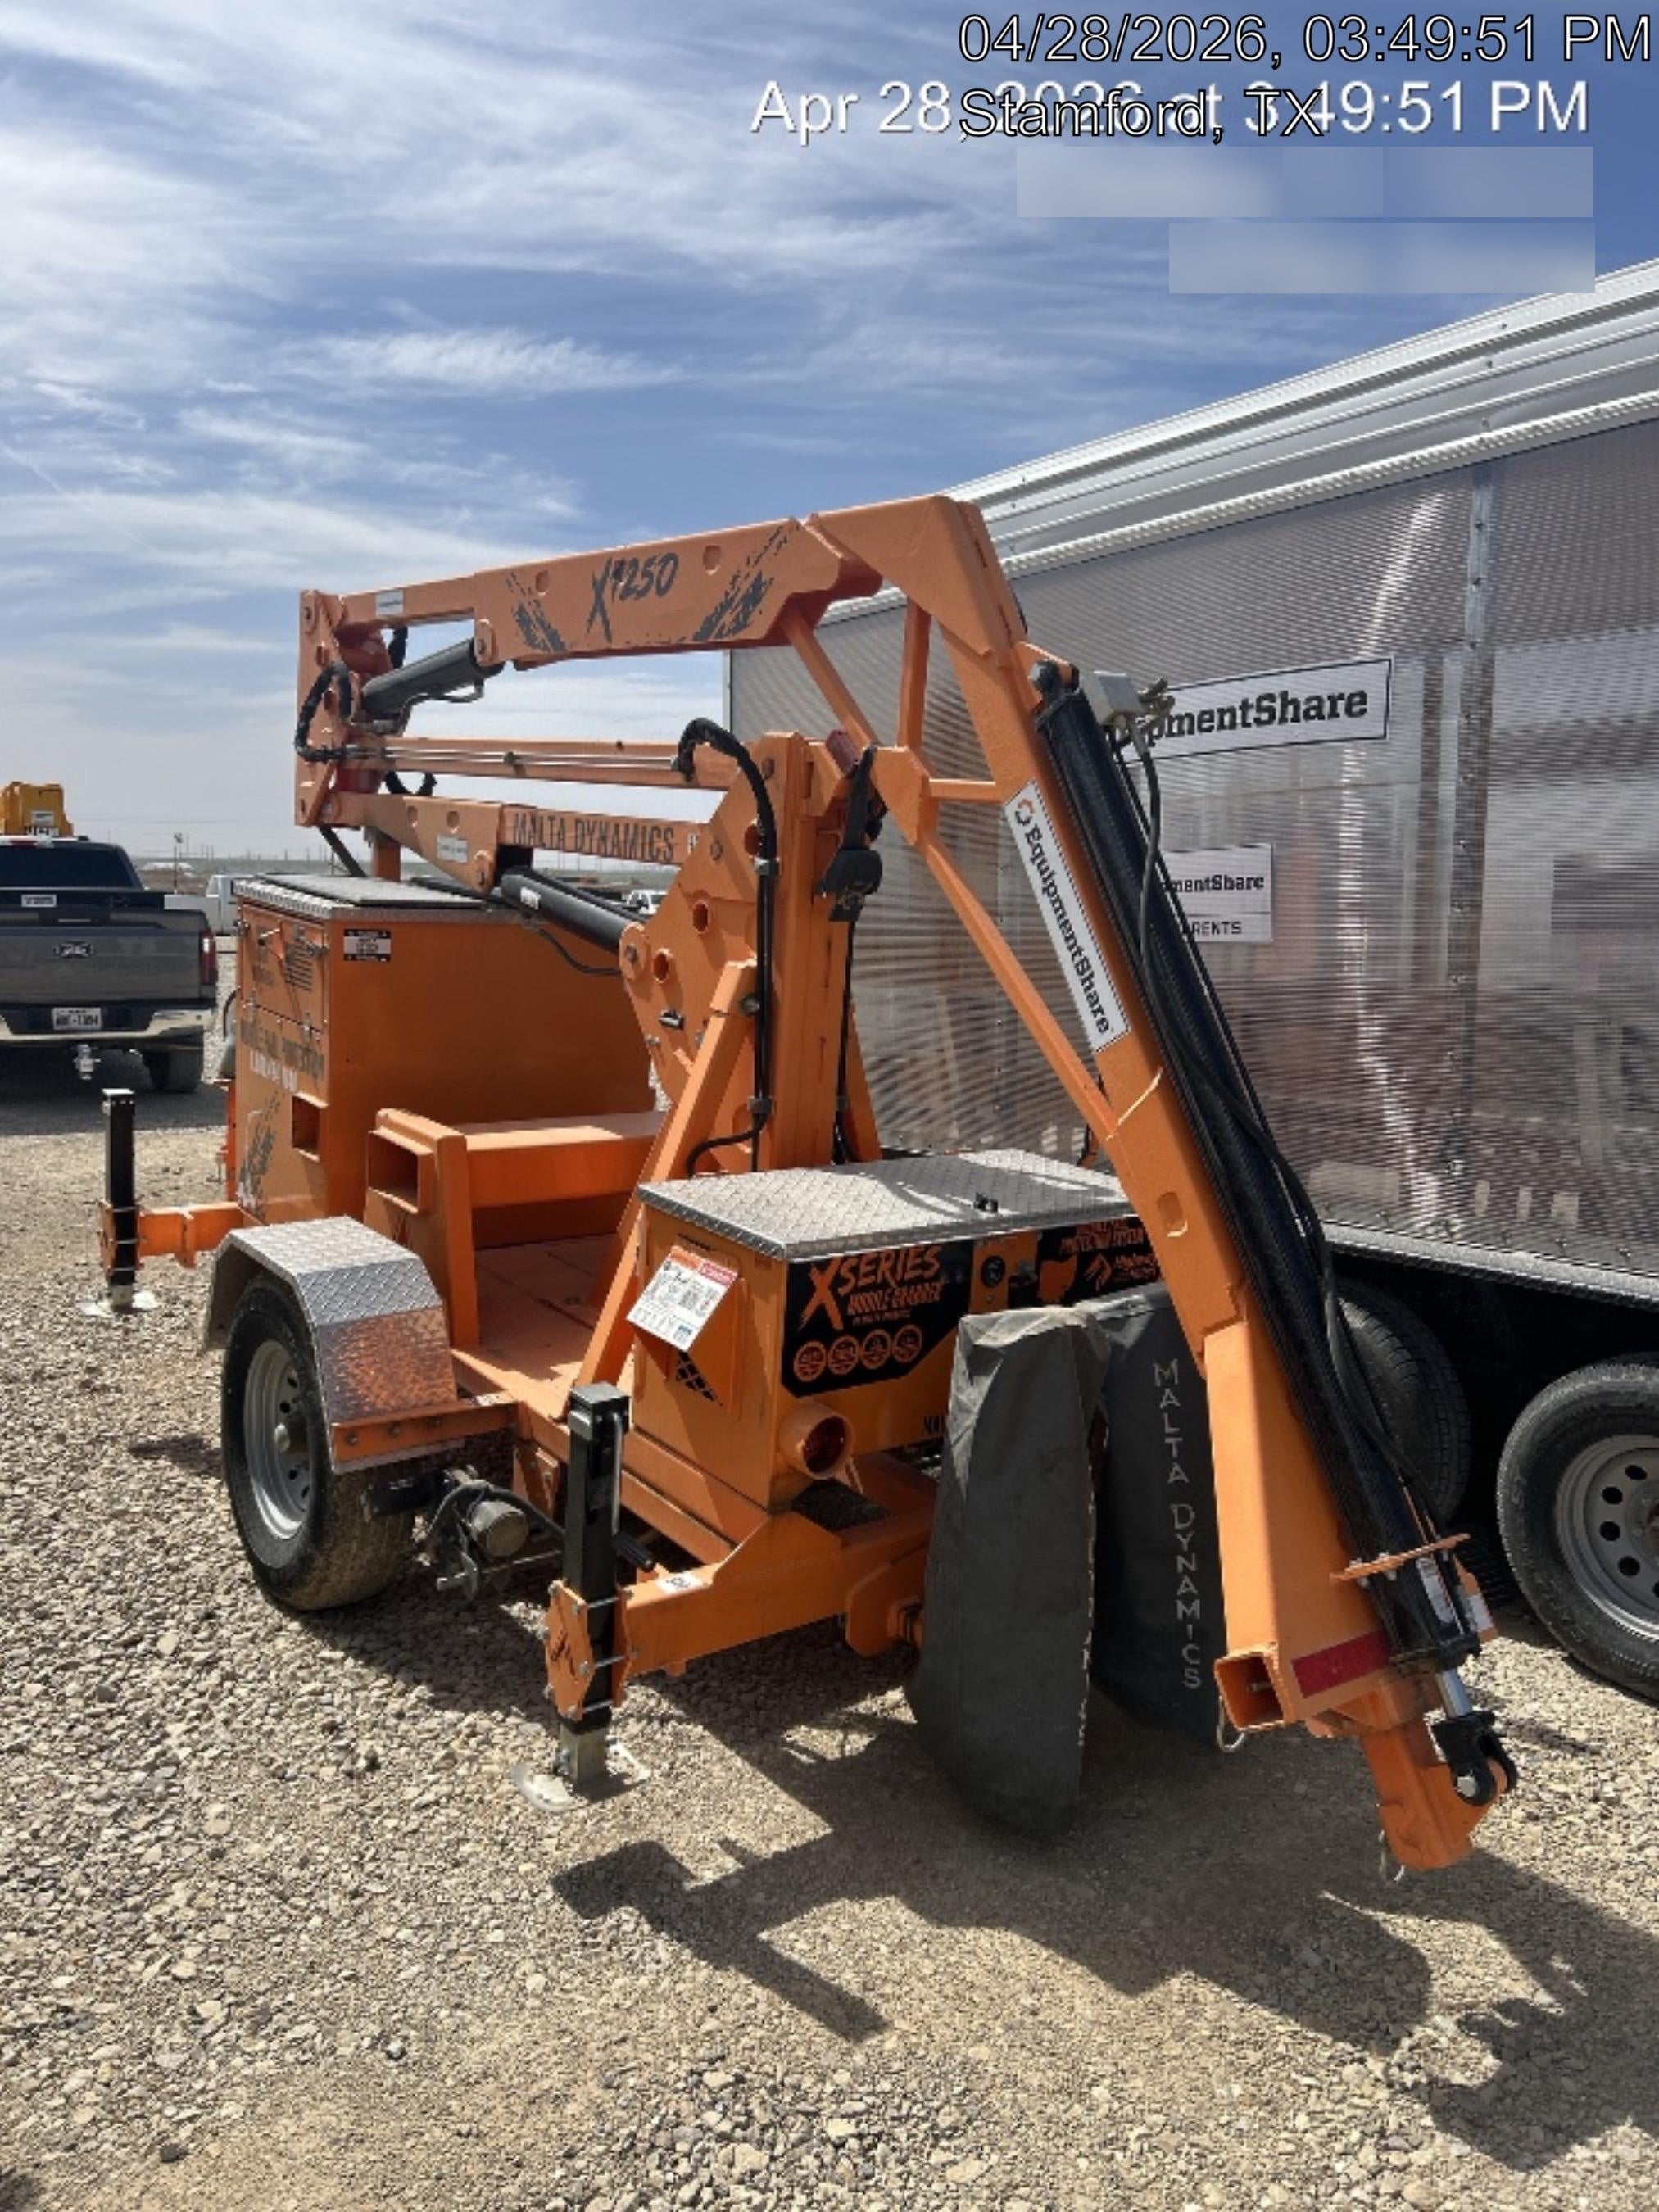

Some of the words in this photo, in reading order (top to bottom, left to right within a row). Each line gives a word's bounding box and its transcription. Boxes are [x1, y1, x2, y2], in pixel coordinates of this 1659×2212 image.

[1117, 689, 1367, 747] pmentShare
[513, 813, 566, 850] MALTA
[575, 818, 674, 863] DYNAMICS
[1160, 874, 1265, 894] mentShare
[1024, 824, 1110, 1034] EquipmentShare
[837, 1243, 944, 1297] SERIES
[1152, 1357, 1190, 1484] MALTA
[1169, 1503, 1202, 1690] DYNAMICS
